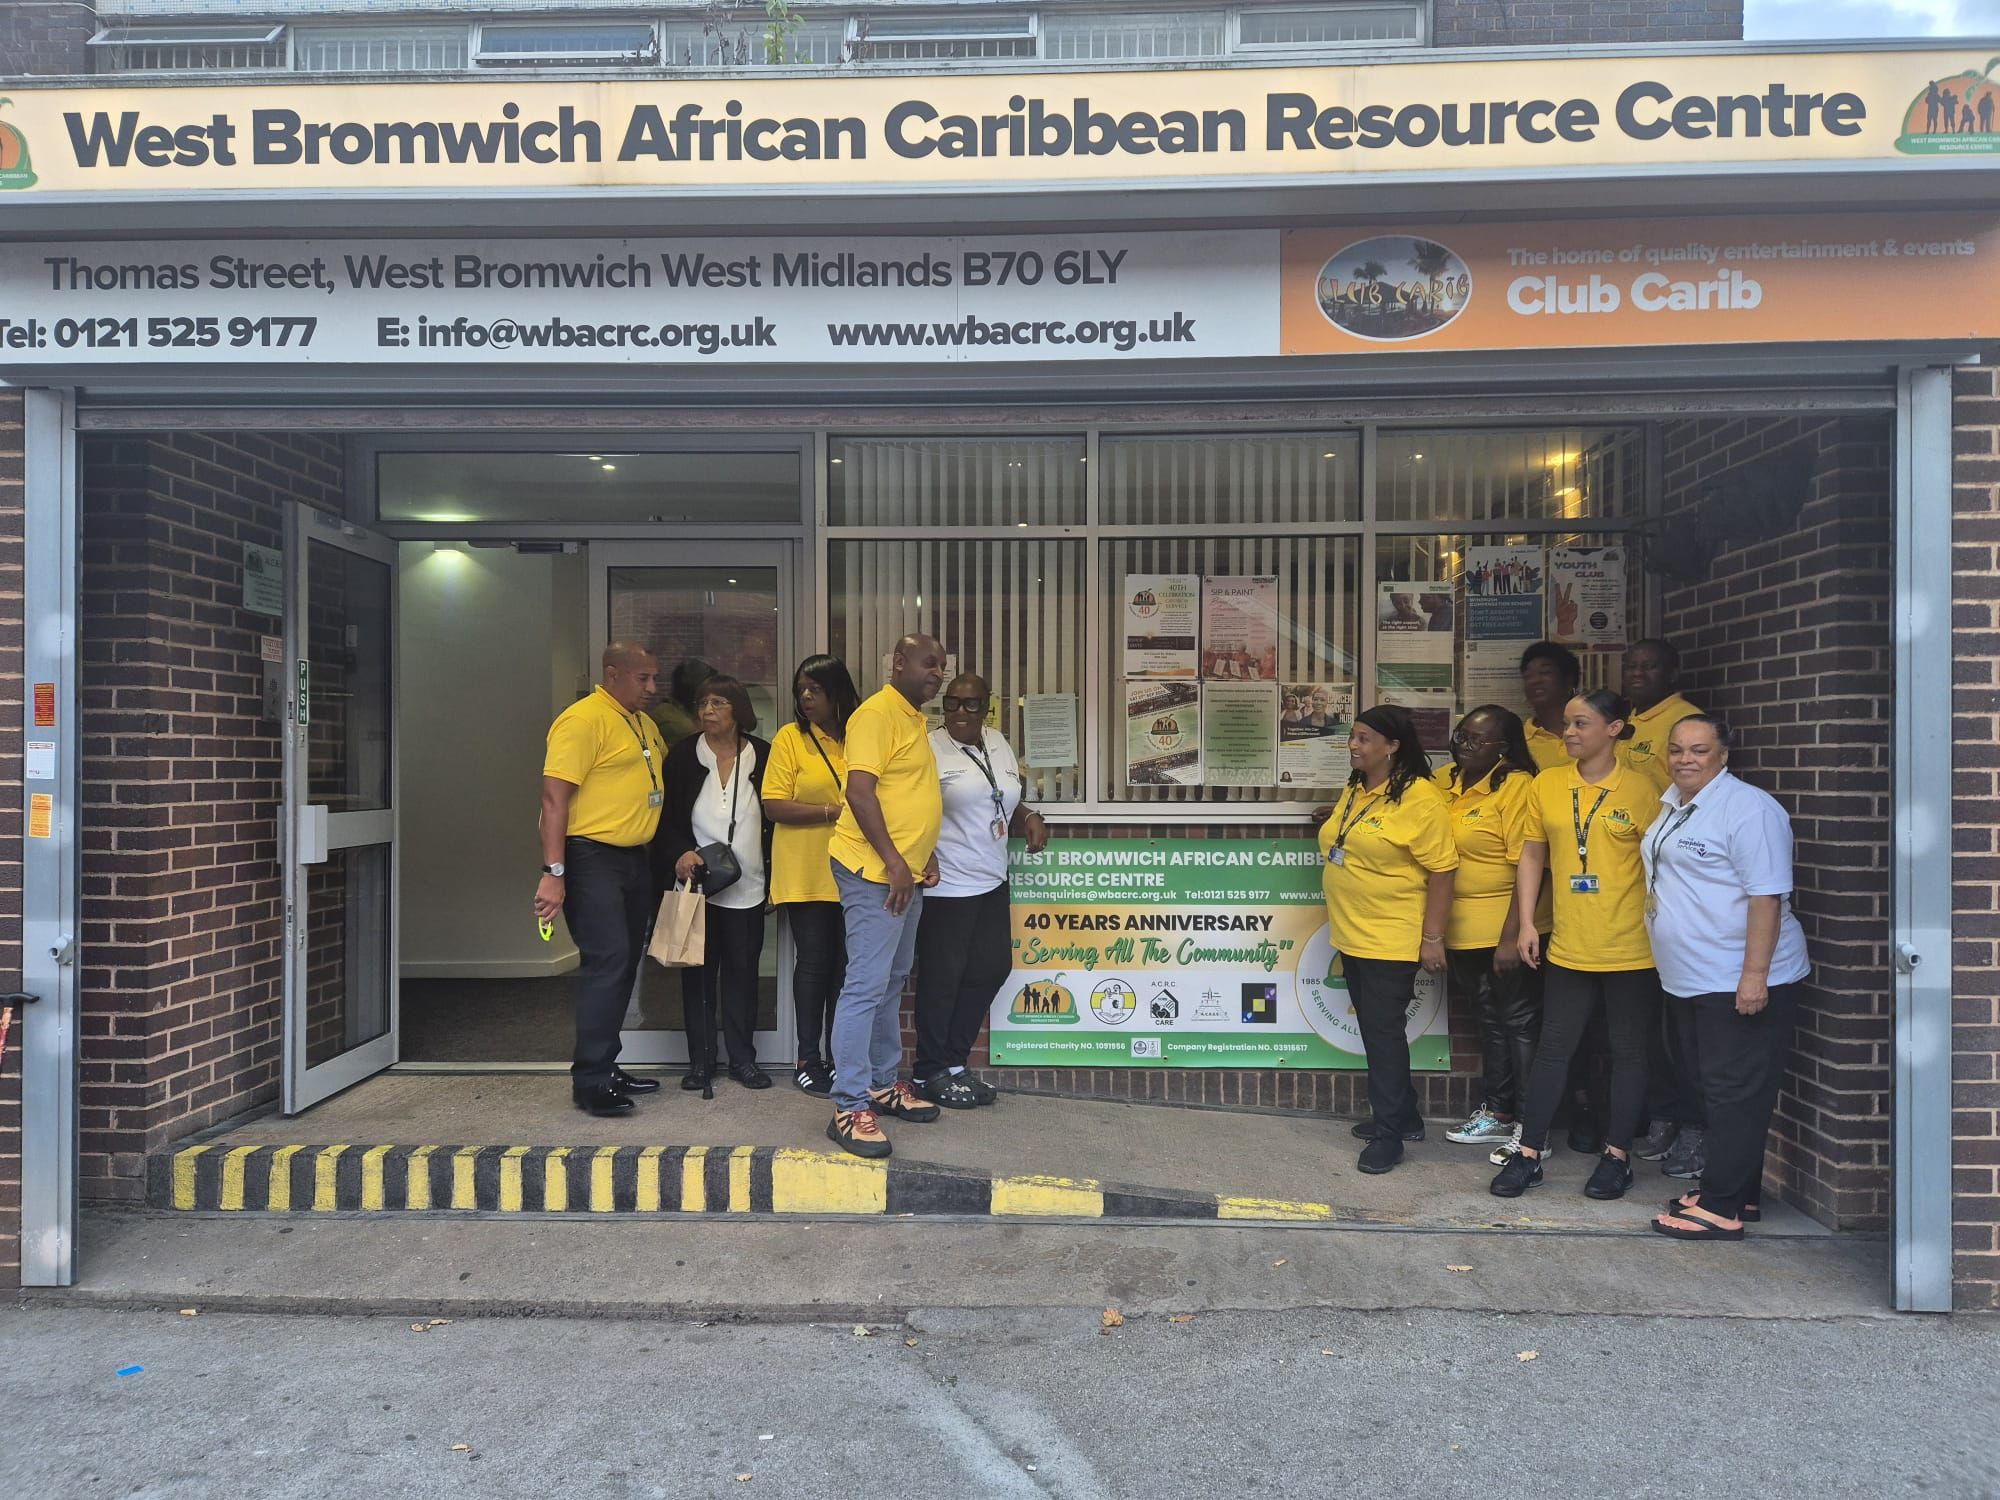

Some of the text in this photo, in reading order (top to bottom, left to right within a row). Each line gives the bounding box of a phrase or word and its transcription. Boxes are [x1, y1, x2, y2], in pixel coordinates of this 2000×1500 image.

[63, 81, 1866, 167] West Bromwich African Caribbean Resource Centre
[1508, 239, 1975, 266] The home of quality entertainment & events
[44, 249, 1128, 294] Thomas Street, West Bromwich West Midlands B70 6LY
[1507, 270, 1762, 315] Club Carib
[54, 318, 137, 347] 0121
[148, 317, 220, 347] 525
[228, 317, 317, 347] 9177
[378, 315, 777, 354] E: info@wbacrc.org.uk
[827, 312, 1196, 351] www.wbacrc.org.uk
[1555, 561, 1597, 569] YOUTH
[1159, 735, 1172, 746] 40
[1679, 839, 1705, 847] Sapphire
[1008, 851, 1054, 866] WEST
[1058, 851, 1166, 866] BROMWICH
[1169, 851, 1253, 866] AFRICAN
[1097, 873, 1165, 887] CENTRE
[1014, 889, 1176, 902] webenquiries@wbacrc.org.uk
[1184, 890, 1225, 899] Tel:0121
[1226, 890, 1246, 899] 525
[1248, 890, 1271, 899] 9177
[1024, 913, 1274, 931] 40 YEARS ANNIVERSARY
[1105, 937, 1135, 965] All
[1140, 937, 1171, 966] The
[1312, 989, 1360, 1036] SERVING ALL
[1006, 1042, 1048, 1051] Registered
[1049, 1042, 1080, 1052] Charity
[1167, 1043, 1207, 1052] Company
[1207, 1043, 1256, 1053] Registration
